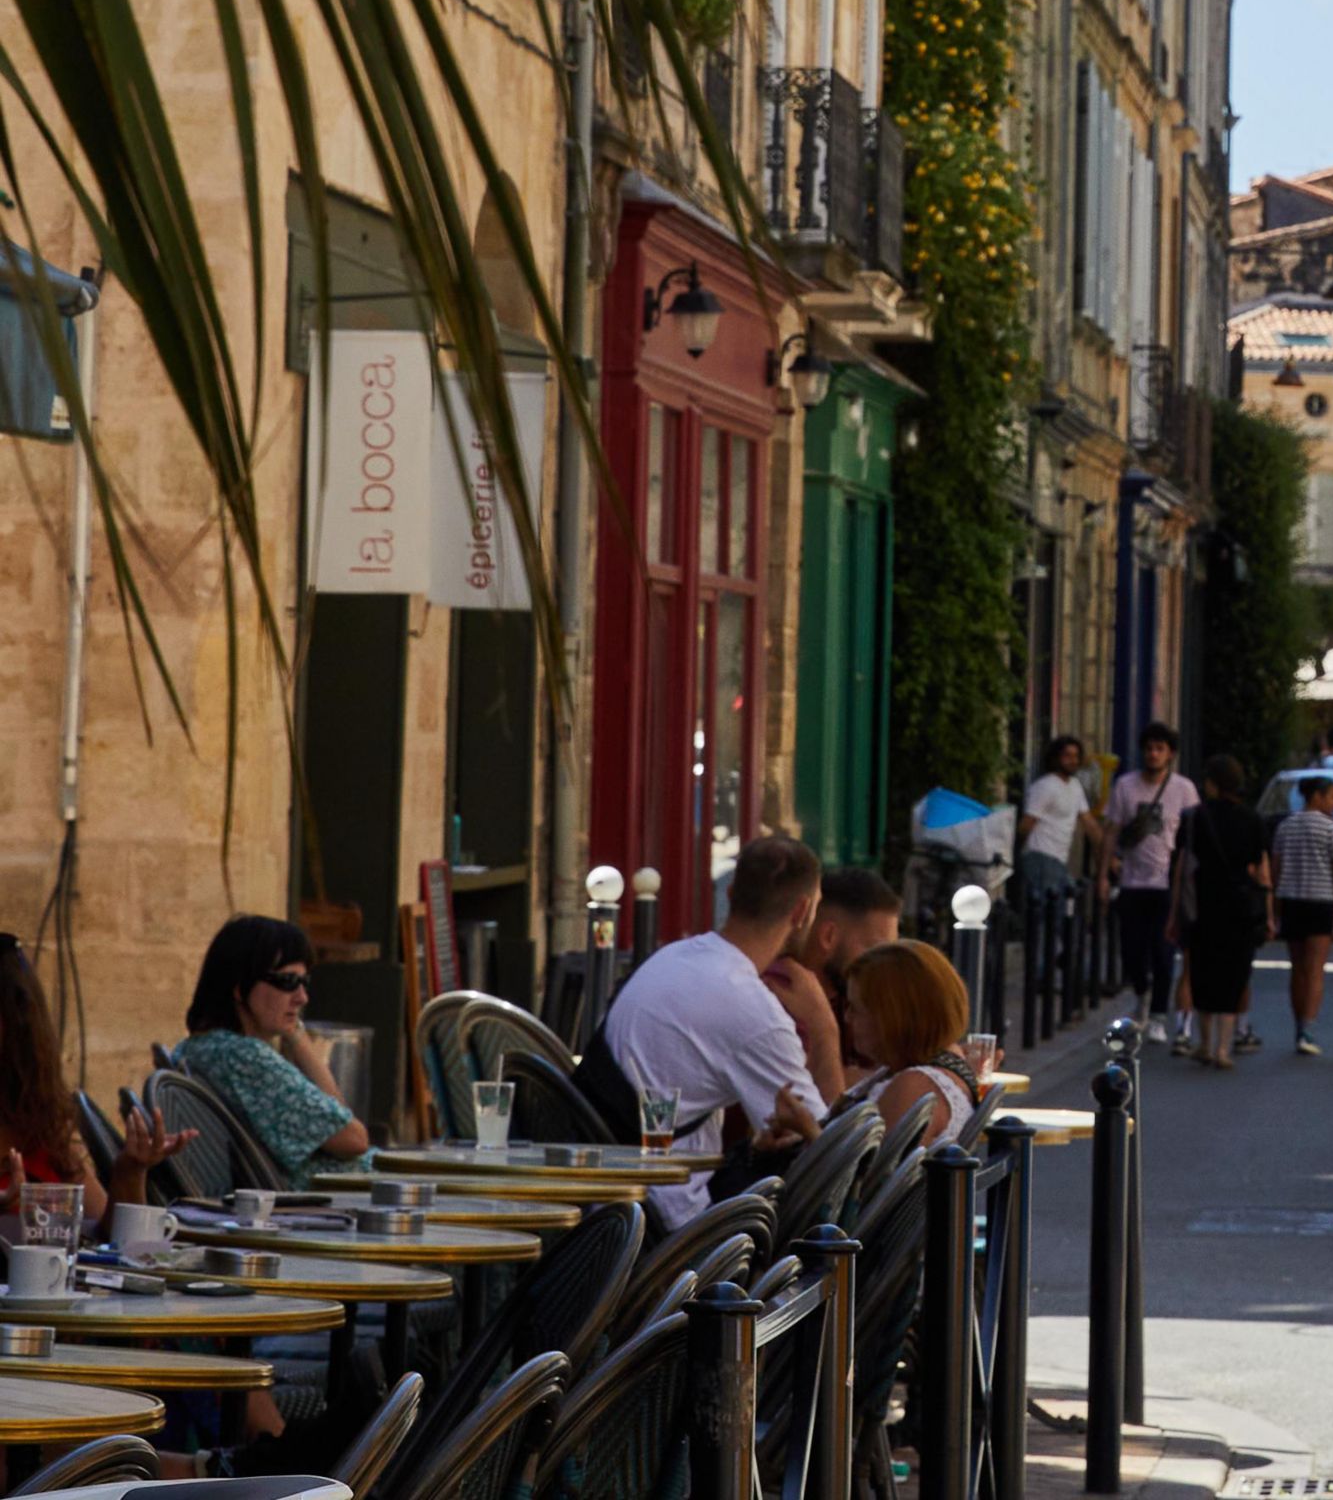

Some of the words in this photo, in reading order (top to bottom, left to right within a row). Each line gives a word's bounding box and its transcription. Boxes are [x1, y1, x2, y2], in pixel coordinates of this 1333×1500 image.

[351, 354, 396, 513] bocca
[349, 528, 394, 574] la
[465, 462, 496, 590] épicerie
